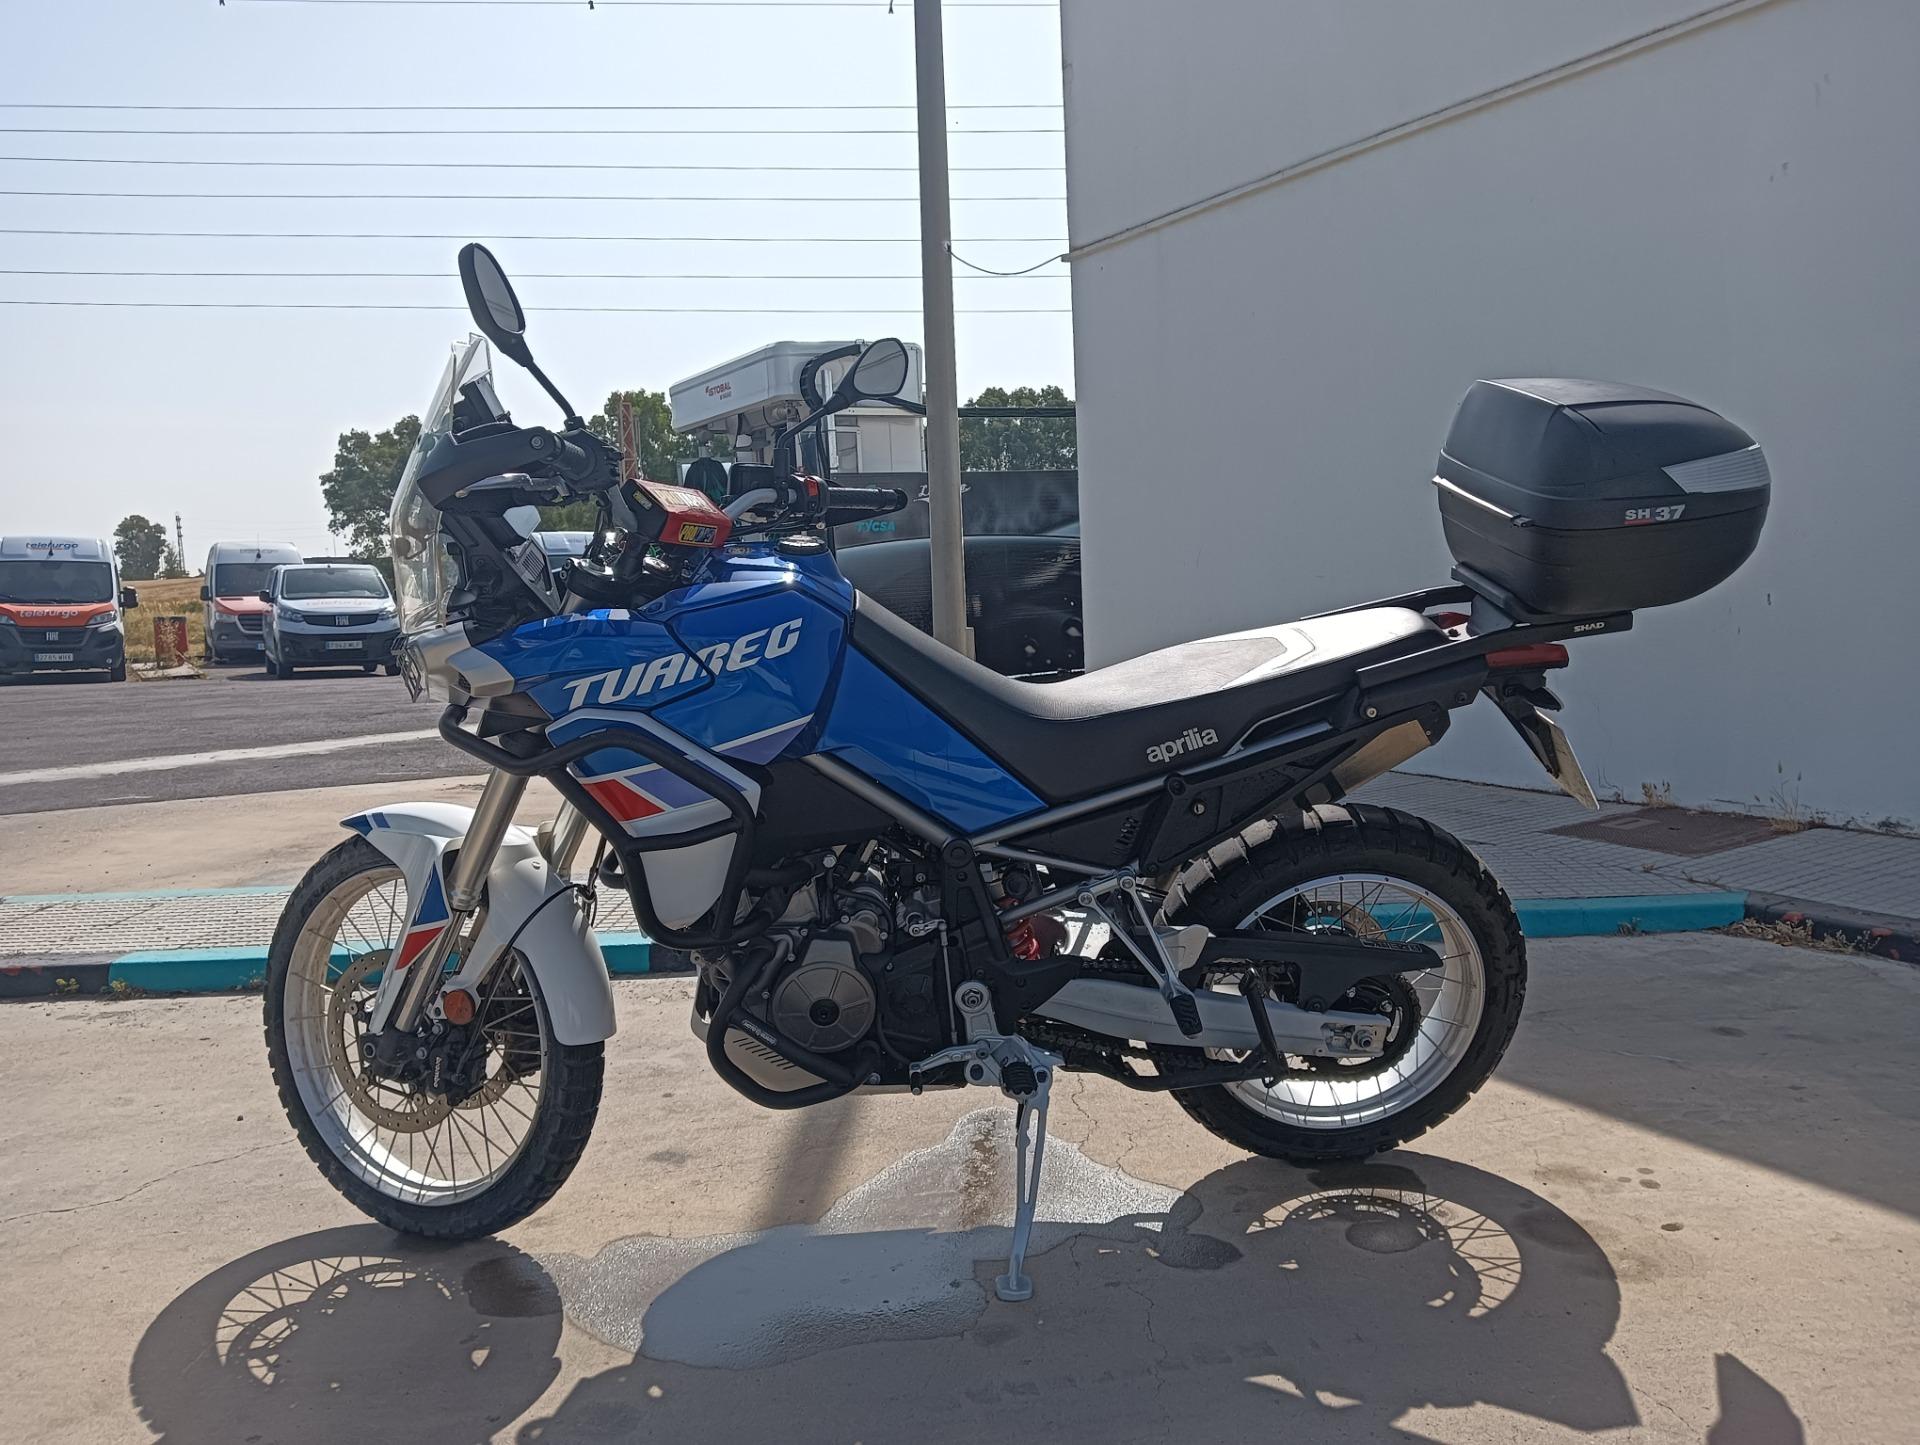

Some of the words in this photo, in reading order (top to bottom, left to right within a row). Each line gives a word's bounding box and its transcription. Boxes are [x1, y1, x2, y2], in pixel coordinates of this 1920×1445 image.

[1625, 509, 1651, 520] SH
[1655, 504, 1686, 521] 37
[20, 607, 79, 618] telefurgo
[335, 616, 349, 626] FIAT
[1573, 621, 1605, 633] SHAD
[46, 632, 59, 641] FIAT
[563, 618, 803, 711] TUAREG
[1146, 728, 1219, 763] aprilia
